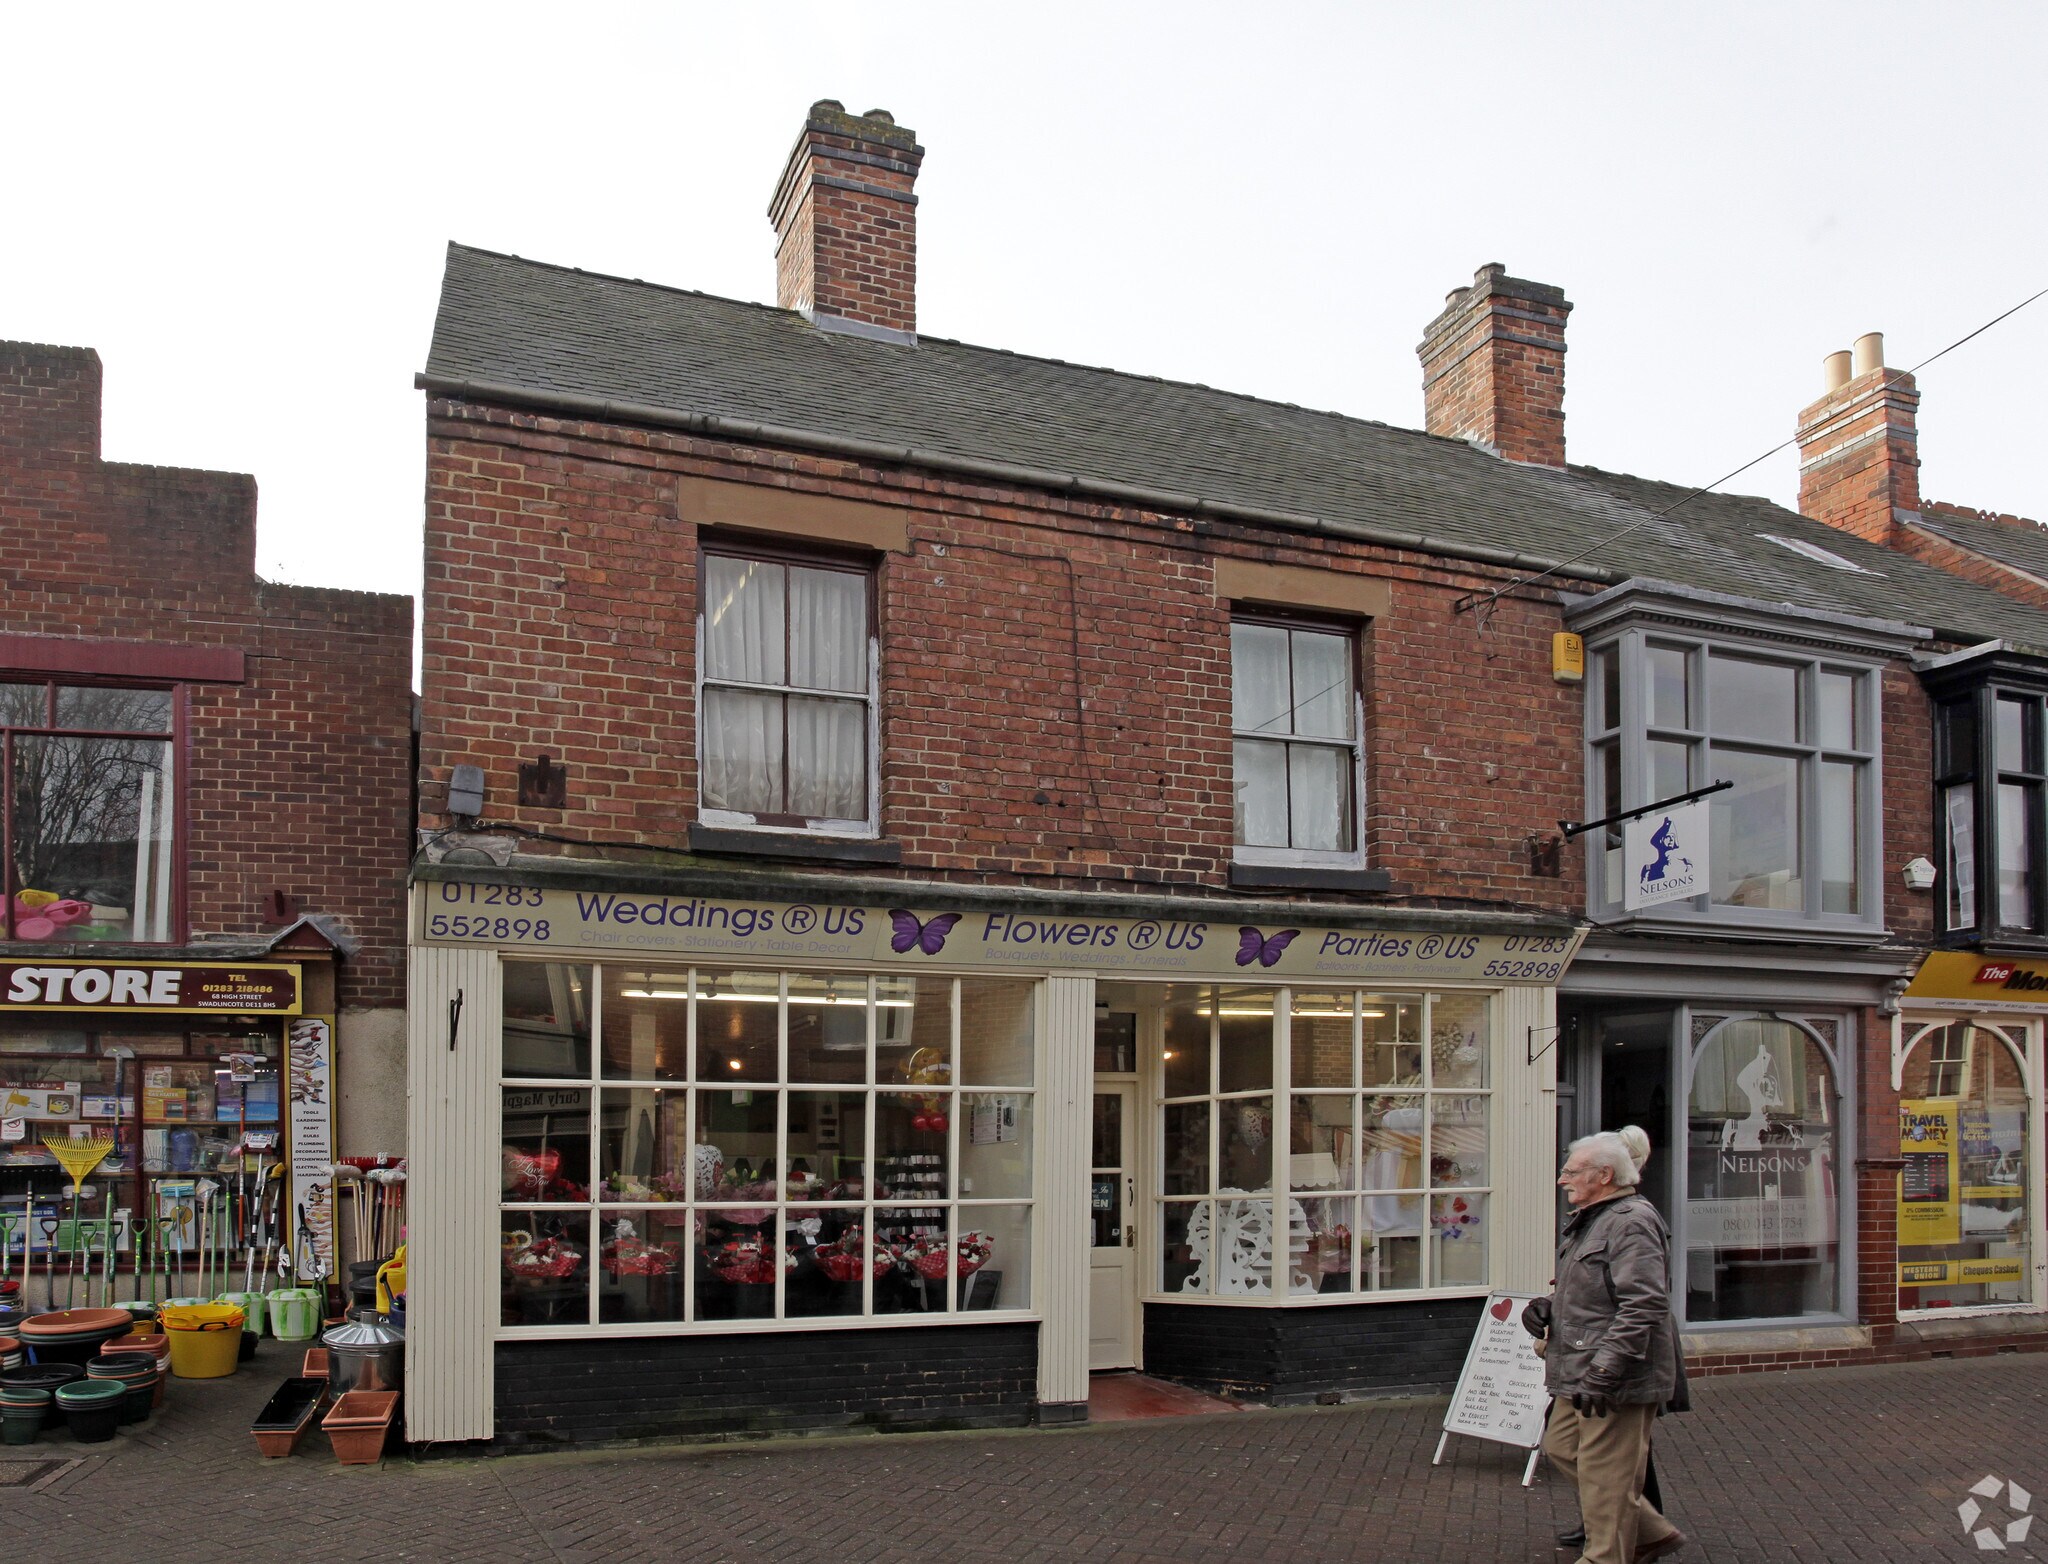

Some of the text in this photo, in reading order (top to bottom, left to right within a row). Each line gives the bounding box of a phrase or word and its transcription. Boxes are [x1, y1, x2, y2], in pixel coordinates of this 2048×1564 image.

[442, 881, 543, 907] 01283
[1640, 875, 1694, 895] NELSONS
[576, 892, 774, 936] Weddings
[823, 906, 866, 936] US
[430, 915, 550, 940] 552898
[982, 913, 1118, 946] Flowers
[1165, 922, 1208, 950] US
[580, 930, 852, 953] Chair covers Stationery Table Decor
[1318, 932, 1412, 958] Parties
[1446, 936, 1480, 960] US
[1504, 936, 1568, 954] 01283
[985, 948, 1187, 966] Bouquets Weddings Funerals
[1314, 961, 1462, 974] Balloons Banners Partyware
[1484, 960, 1560, 979] 552898
[1982, 967, 2009, 979] The
[7, 967, 182, 1004] STORE
[228, 974, 247, 982] TEL
[202, 984, 273, 993] 01283 218486
[1902, 1114, 1948, 1127] TRAVEL
[1722, 1155, 1807, 1174] NELSONS
[1092, 1199, 1109, 1208] EN
[1903, 1265, 1939, 1274] WESTERN
[1963, 1264, 2019, 1276] Cheques Cashed
[1508, 1380, 1538, 1390] CHOCOLATE
